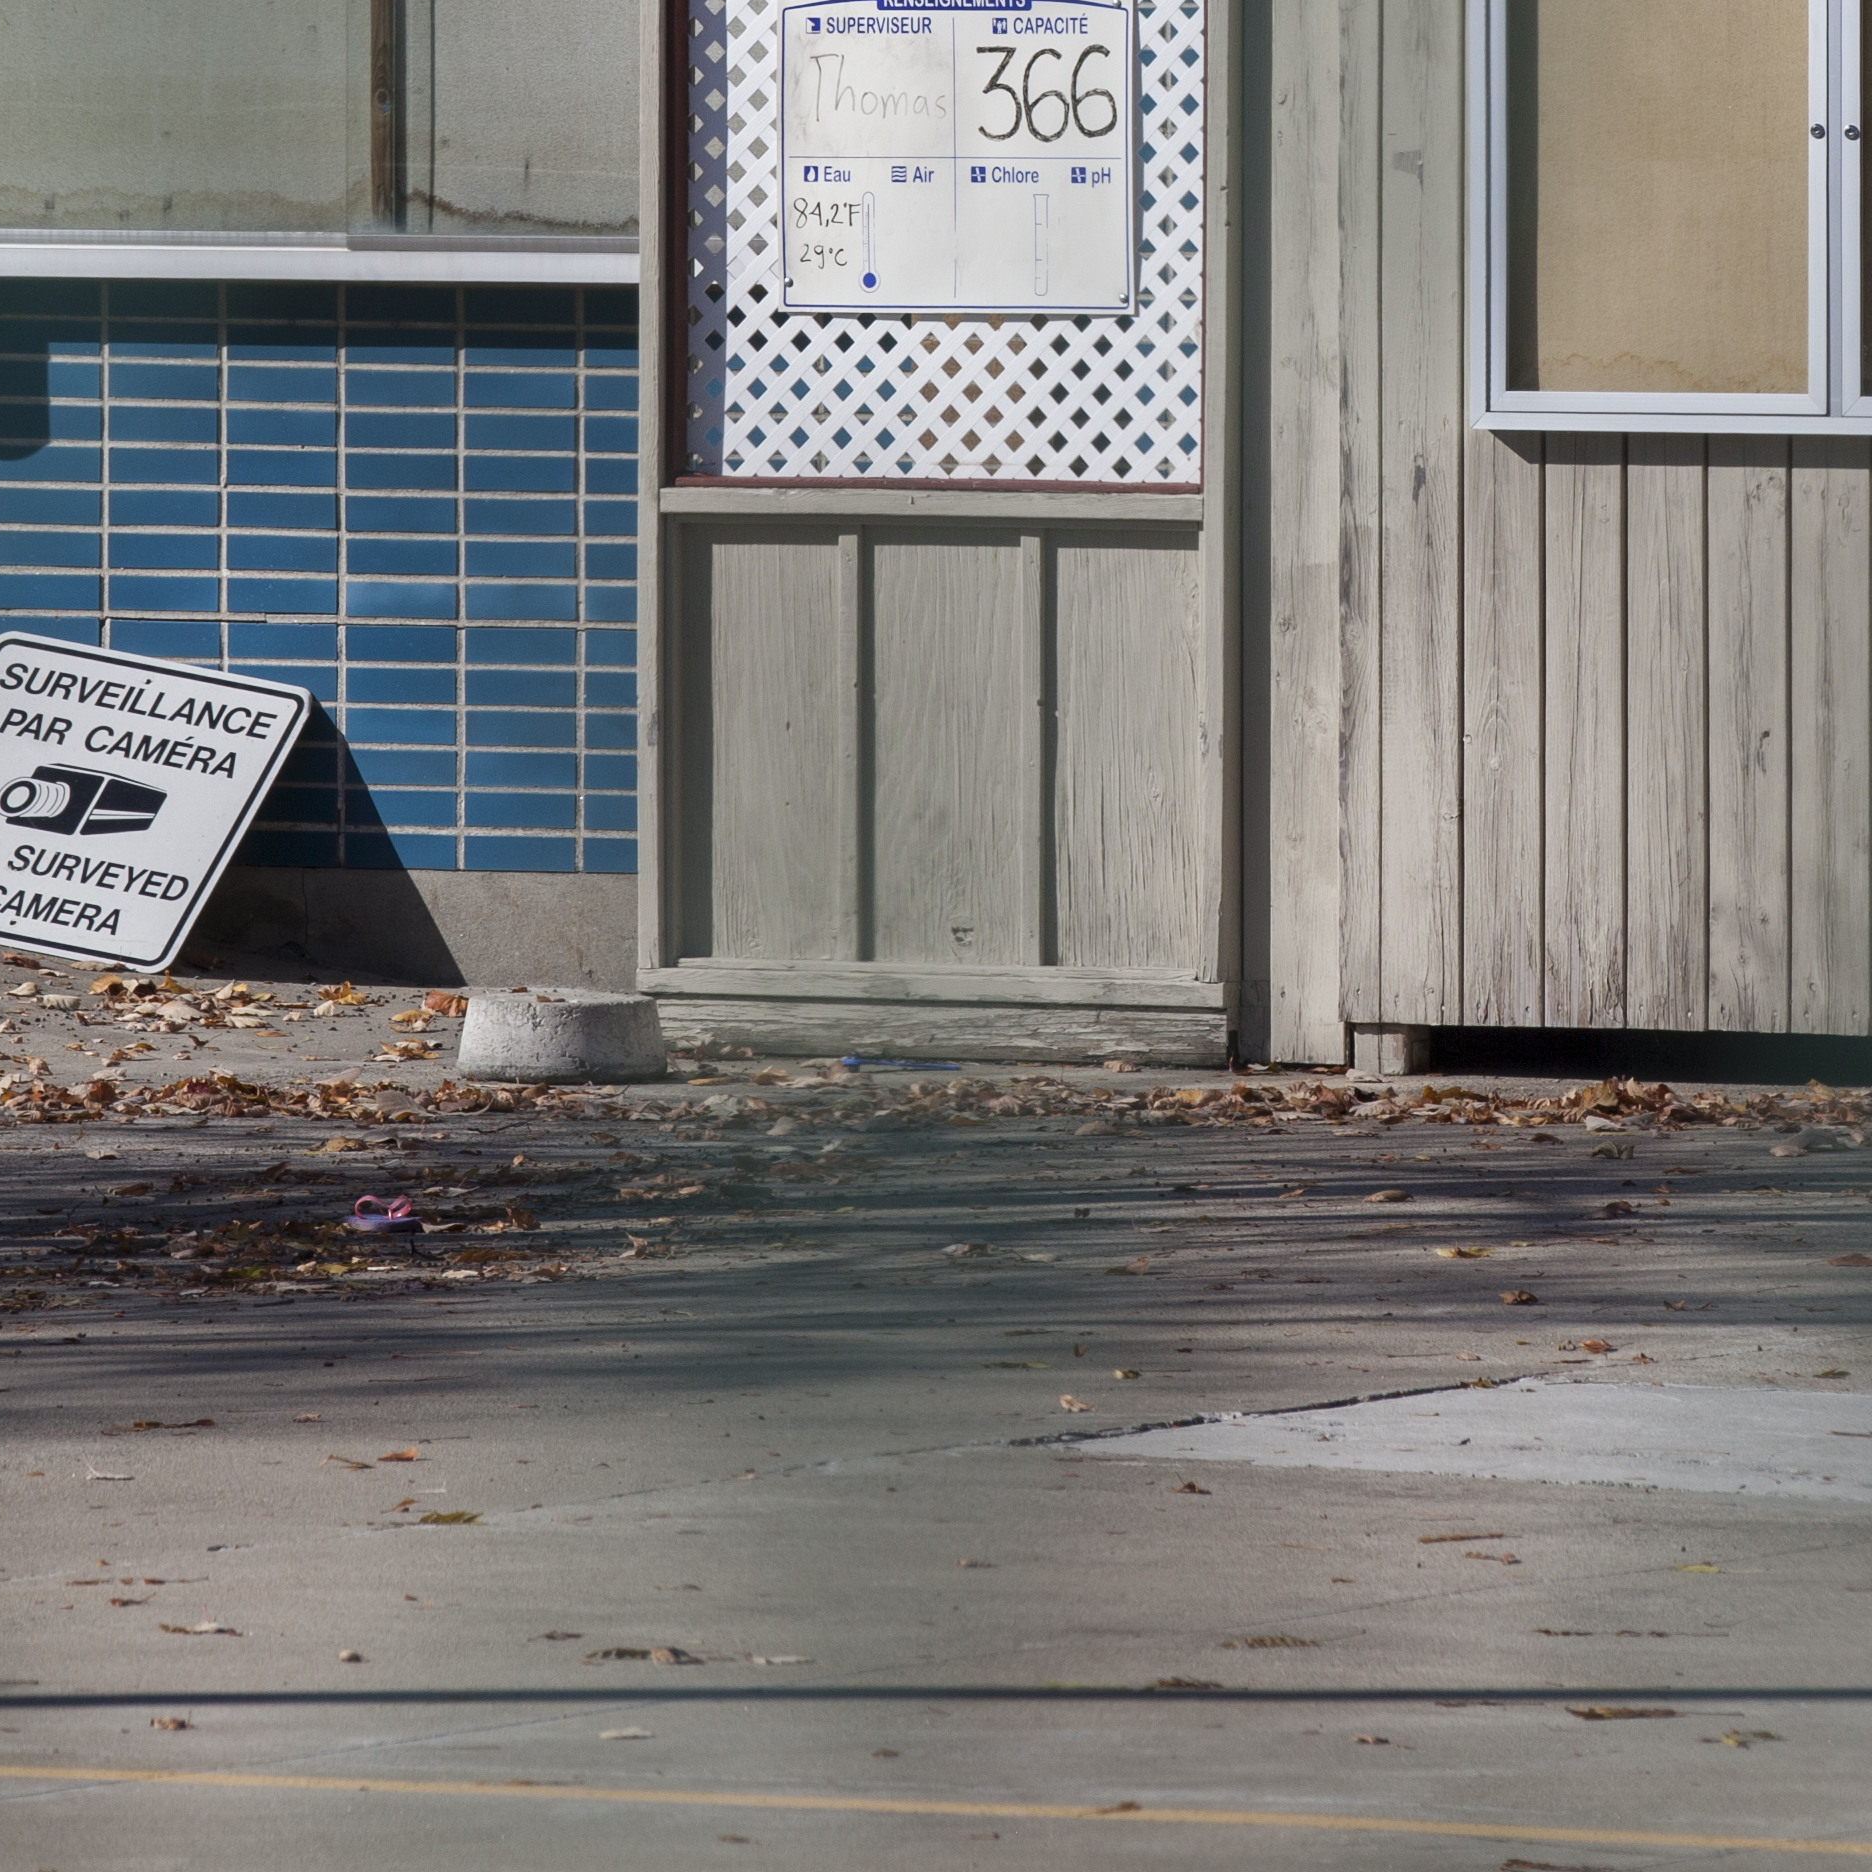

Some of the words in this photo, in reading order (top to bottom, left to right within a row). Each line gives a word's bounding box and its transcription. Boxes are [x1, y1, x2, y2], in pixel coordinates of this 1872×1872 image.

[826, 16, 932, 34] SUPERVISEUR
[1013, 13, 1089, 35] CAPACITÉ
[810, 54, 947, 122] Thomas
[976, 44, 1118, 143] 366
[823, 165, 851, 183] Eau
[912, 166, 935, 183] Air
[991, 166, 1039, 183] Chlore
[1091, 167, 1111, 187] pH
[0, 662, 278, 740] SURVEILLANCE
[0, 709, 72, 745] PAR
[84, 725, 238, 780] CAMÉRA
[7, 844, 190, 902] SURVEYED
